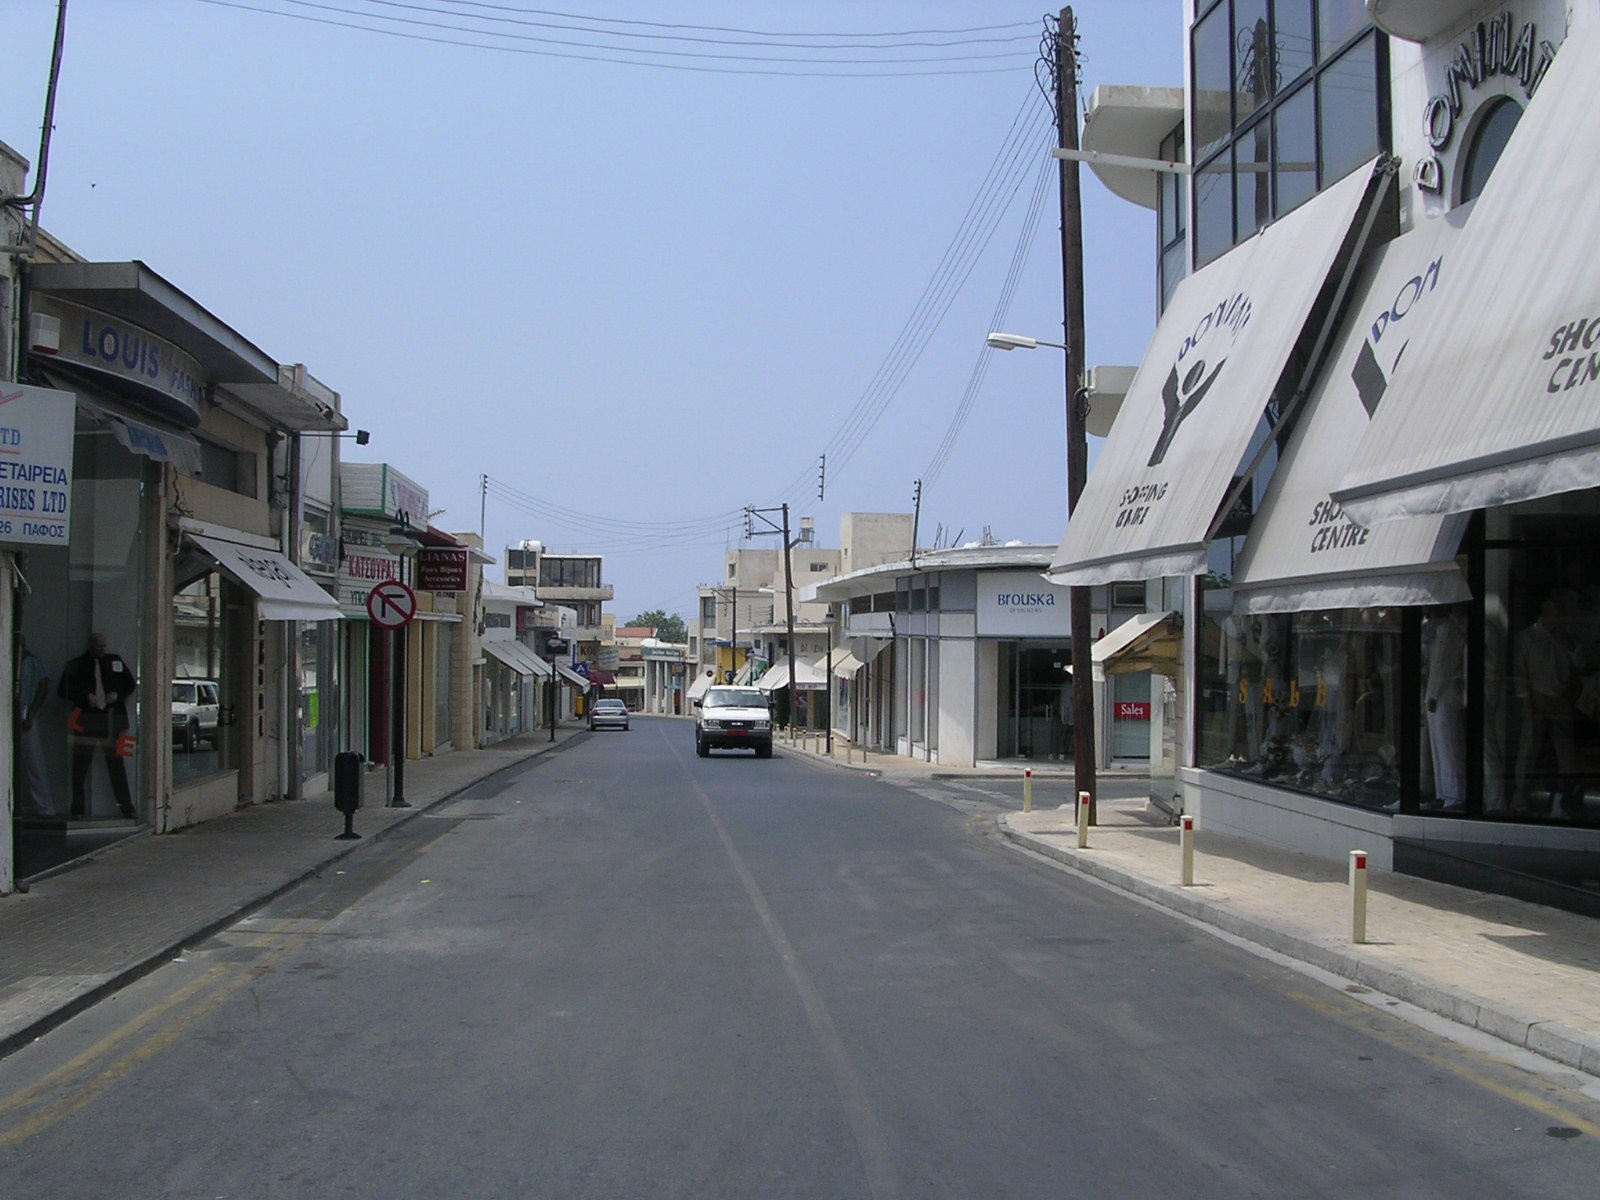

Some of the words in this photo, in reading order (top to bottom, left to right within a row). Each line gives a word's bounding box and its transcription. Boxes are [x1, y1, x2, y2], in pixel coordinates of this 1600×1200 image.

[82, 319, 160, 378] LOUIS
[0, 427, 21, 446] TD
[42, 490, 67, 514] LTD
[23, 522, 65, 538] ΠΑΦΟΣ
[1311, 524, 1370, 553] CENTRE
[1121, 703, 1144, 715] Sales
